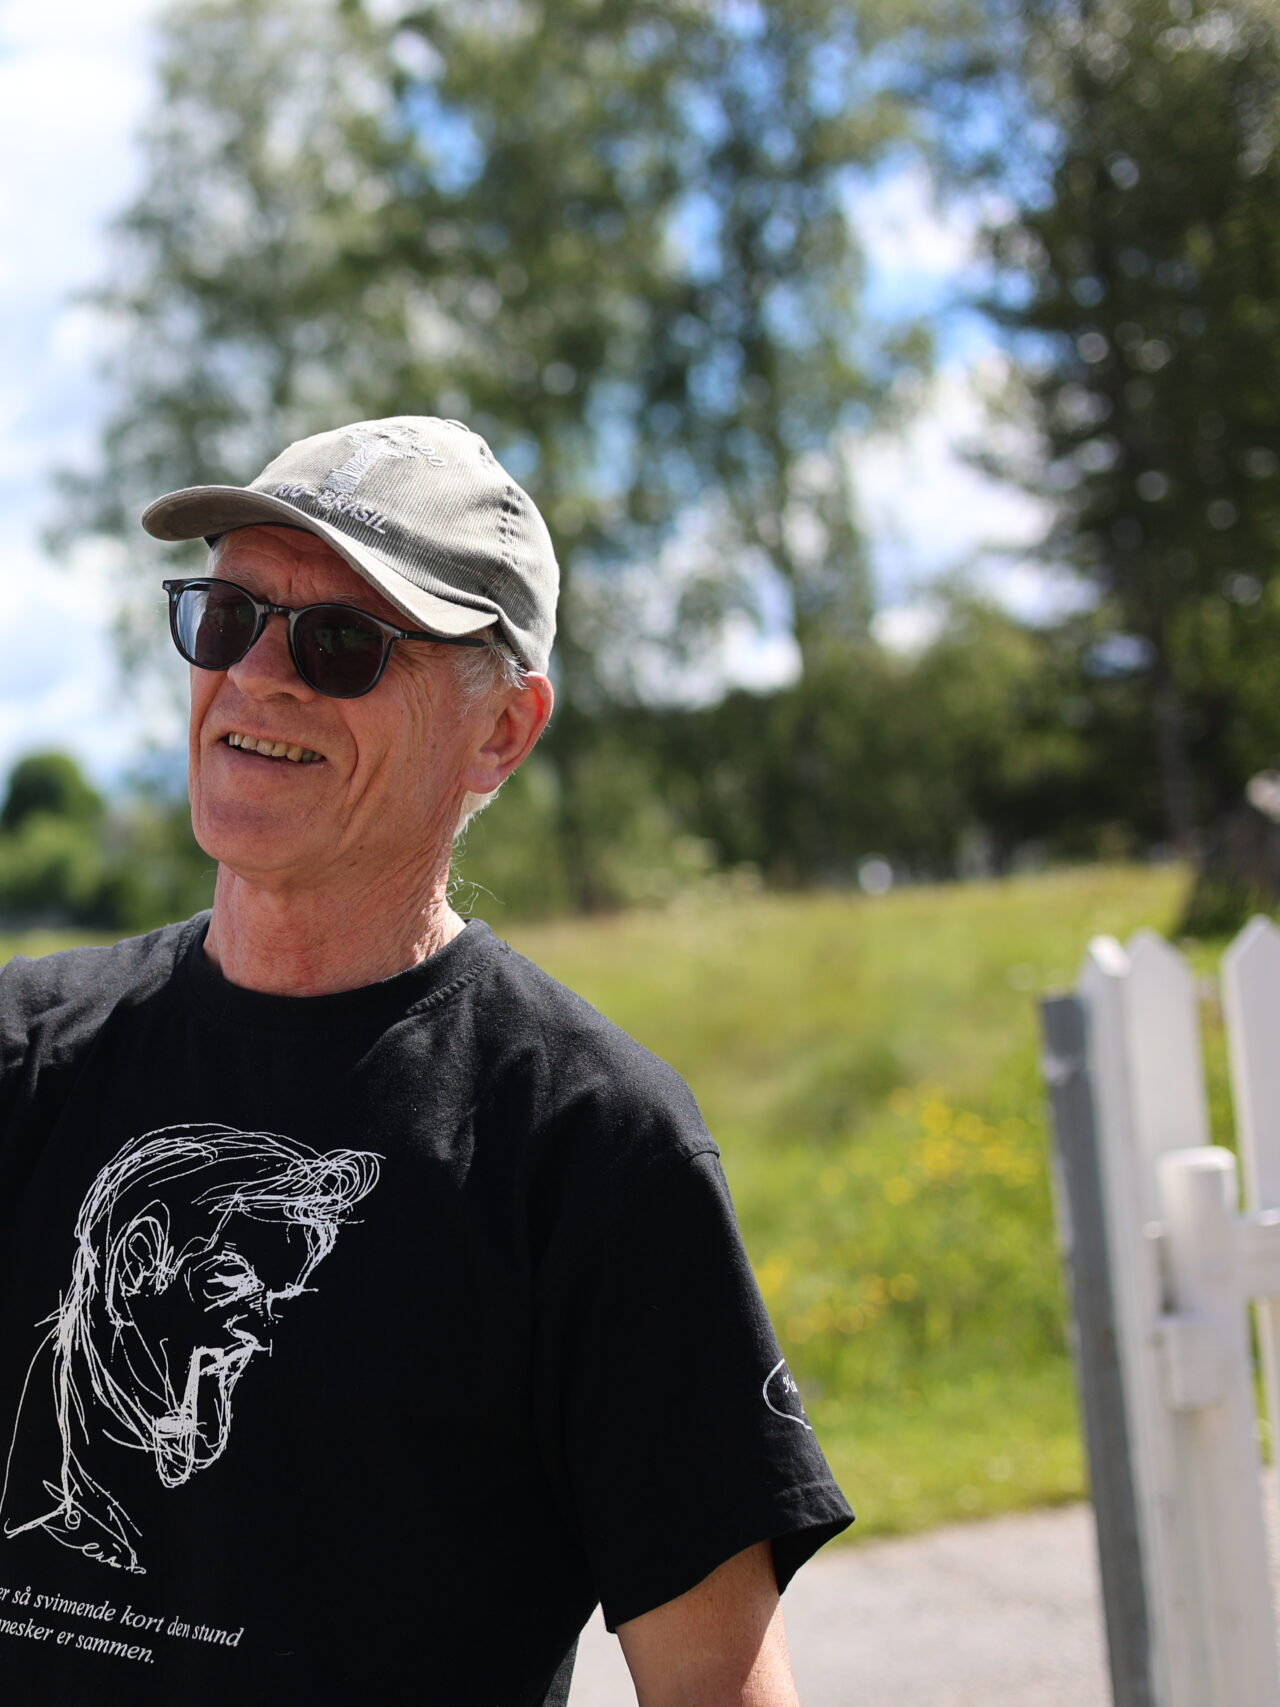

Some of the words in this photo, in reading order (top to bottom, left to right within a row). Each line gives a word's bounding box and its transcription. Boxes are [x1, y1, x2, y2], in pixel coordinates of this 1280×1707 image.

[12, 1586, 31, 1605] så
[34, 1593, 116, 1621] svinnende
[120, 1605, 164, 1632] kort
[167, 1616, 190, 1638] den
[192, 1624, 244, 1647] stund
[57, 1631, 74, 1645] er
[76, 1635, 154, 1663] sammen.
